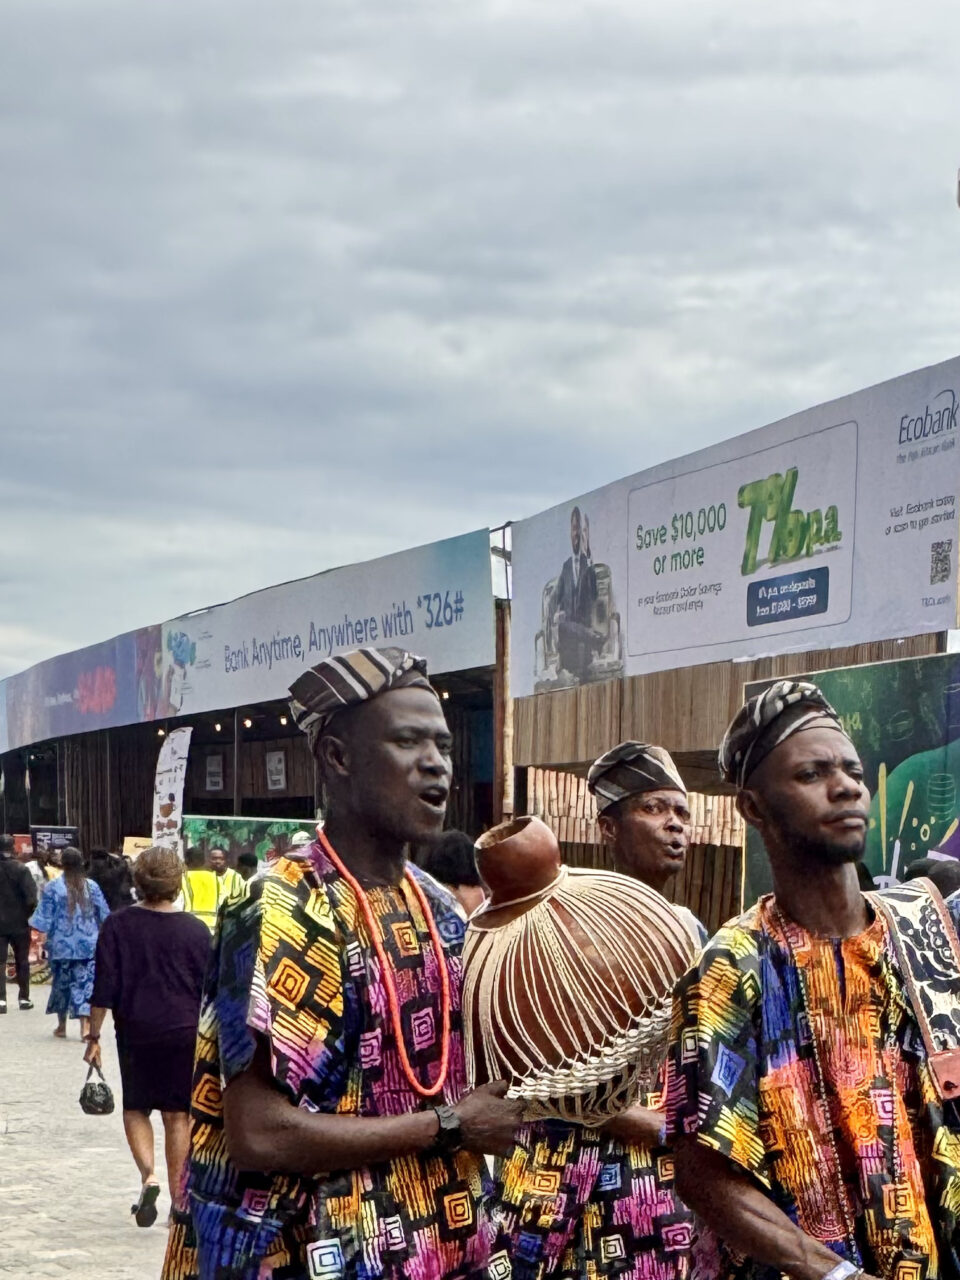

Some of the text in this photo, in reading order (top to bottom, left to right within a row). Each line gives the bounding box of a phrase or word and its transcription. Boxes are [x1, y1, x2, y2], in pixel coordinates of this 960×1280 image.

[898, 389, 960, 445] Ecobank
[636, 502, 727, 550] Save $10,000
[653, 547, 704, 575] or more
[225, 645, 249, 673] Bank
[252, 629, 306, 671] Anytime,
[309, 614, 378, 652] Anywhere
[381, 601, 414, 638] with
